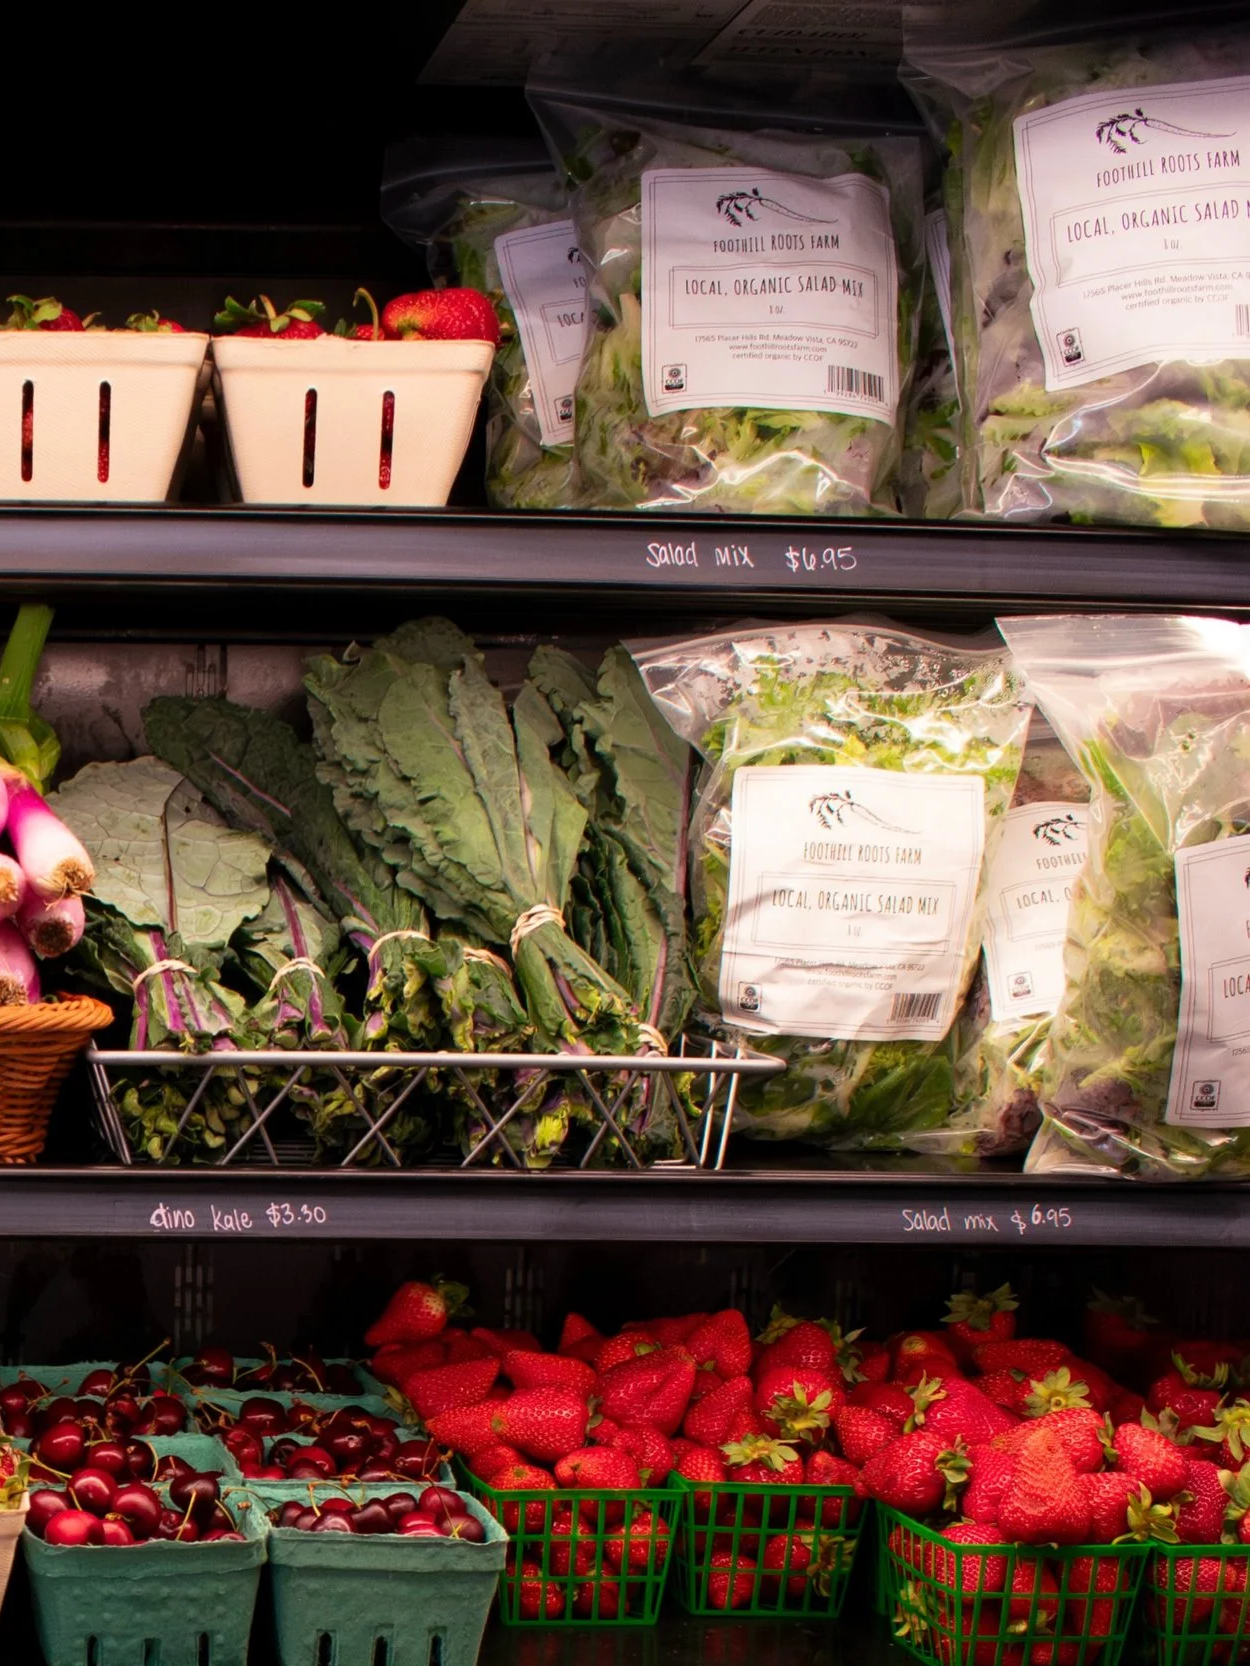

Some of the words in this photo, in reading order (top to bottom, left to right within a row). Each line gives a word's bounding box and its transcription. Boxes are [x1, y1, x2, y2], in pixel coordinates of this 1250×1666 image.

[1096, 159, 1155, 188] FOOTHILL
[1161, 152, 1201, 175] ROOTS
[1207, 149, 1241, 169] FARM
[1066, 215, 1116, 244] LOCAL,
[1121, 204, 1189, 232] ORGANIC
[1194, 198, 1240, 222] SALAD
[714, 236, 766, 253] FOOTHILL
[771, 233, 806, 251] ROOTS
[810, 233, 841, 250] FARM
[733, 276, 793, 296] ORGANIC
[797, 275, 838, 293] SALAD
[842, 279, 864, 298] MIX
[1107, 281, 1132, 294] Placer
[1134, 277, 1153, 289] Hills
[1170, 272, 1206, 284] Meadow
[1125, 296, 1161, 312] certified
[1162, 294, 1193, 306] organic
[694, 334, 716, 344] 17565
[717, 333, 740, 343] Placer
[742, 333, 758, 342] Hills
[772, 333, 804, 344] Meadow
[826, 336, 837, 345] CA
[729, 343, 828, 354] www.foothillrootsfarm.com
[732, 351, 763, 361] certified
[764, 352, 792, 362] organic
[784, 545, 857, 573] $6.95
[803, 841, 854, 862] FOOTHILL
[857, 844, 891, 864] ROOTS
[895, 846, 923, 866] FARM
[772, 888, 812, 911] LOCAL,
[817, 890, 873, 913] ORGANIC
[877, 894, 914, 916] SALAD
[917, 895, 940, 916] MIX
[149, 1202, 196, 1231] dino
[265, 1202, 327, 1228] $3.30
[963, 1213, 1000, 1233] mix
